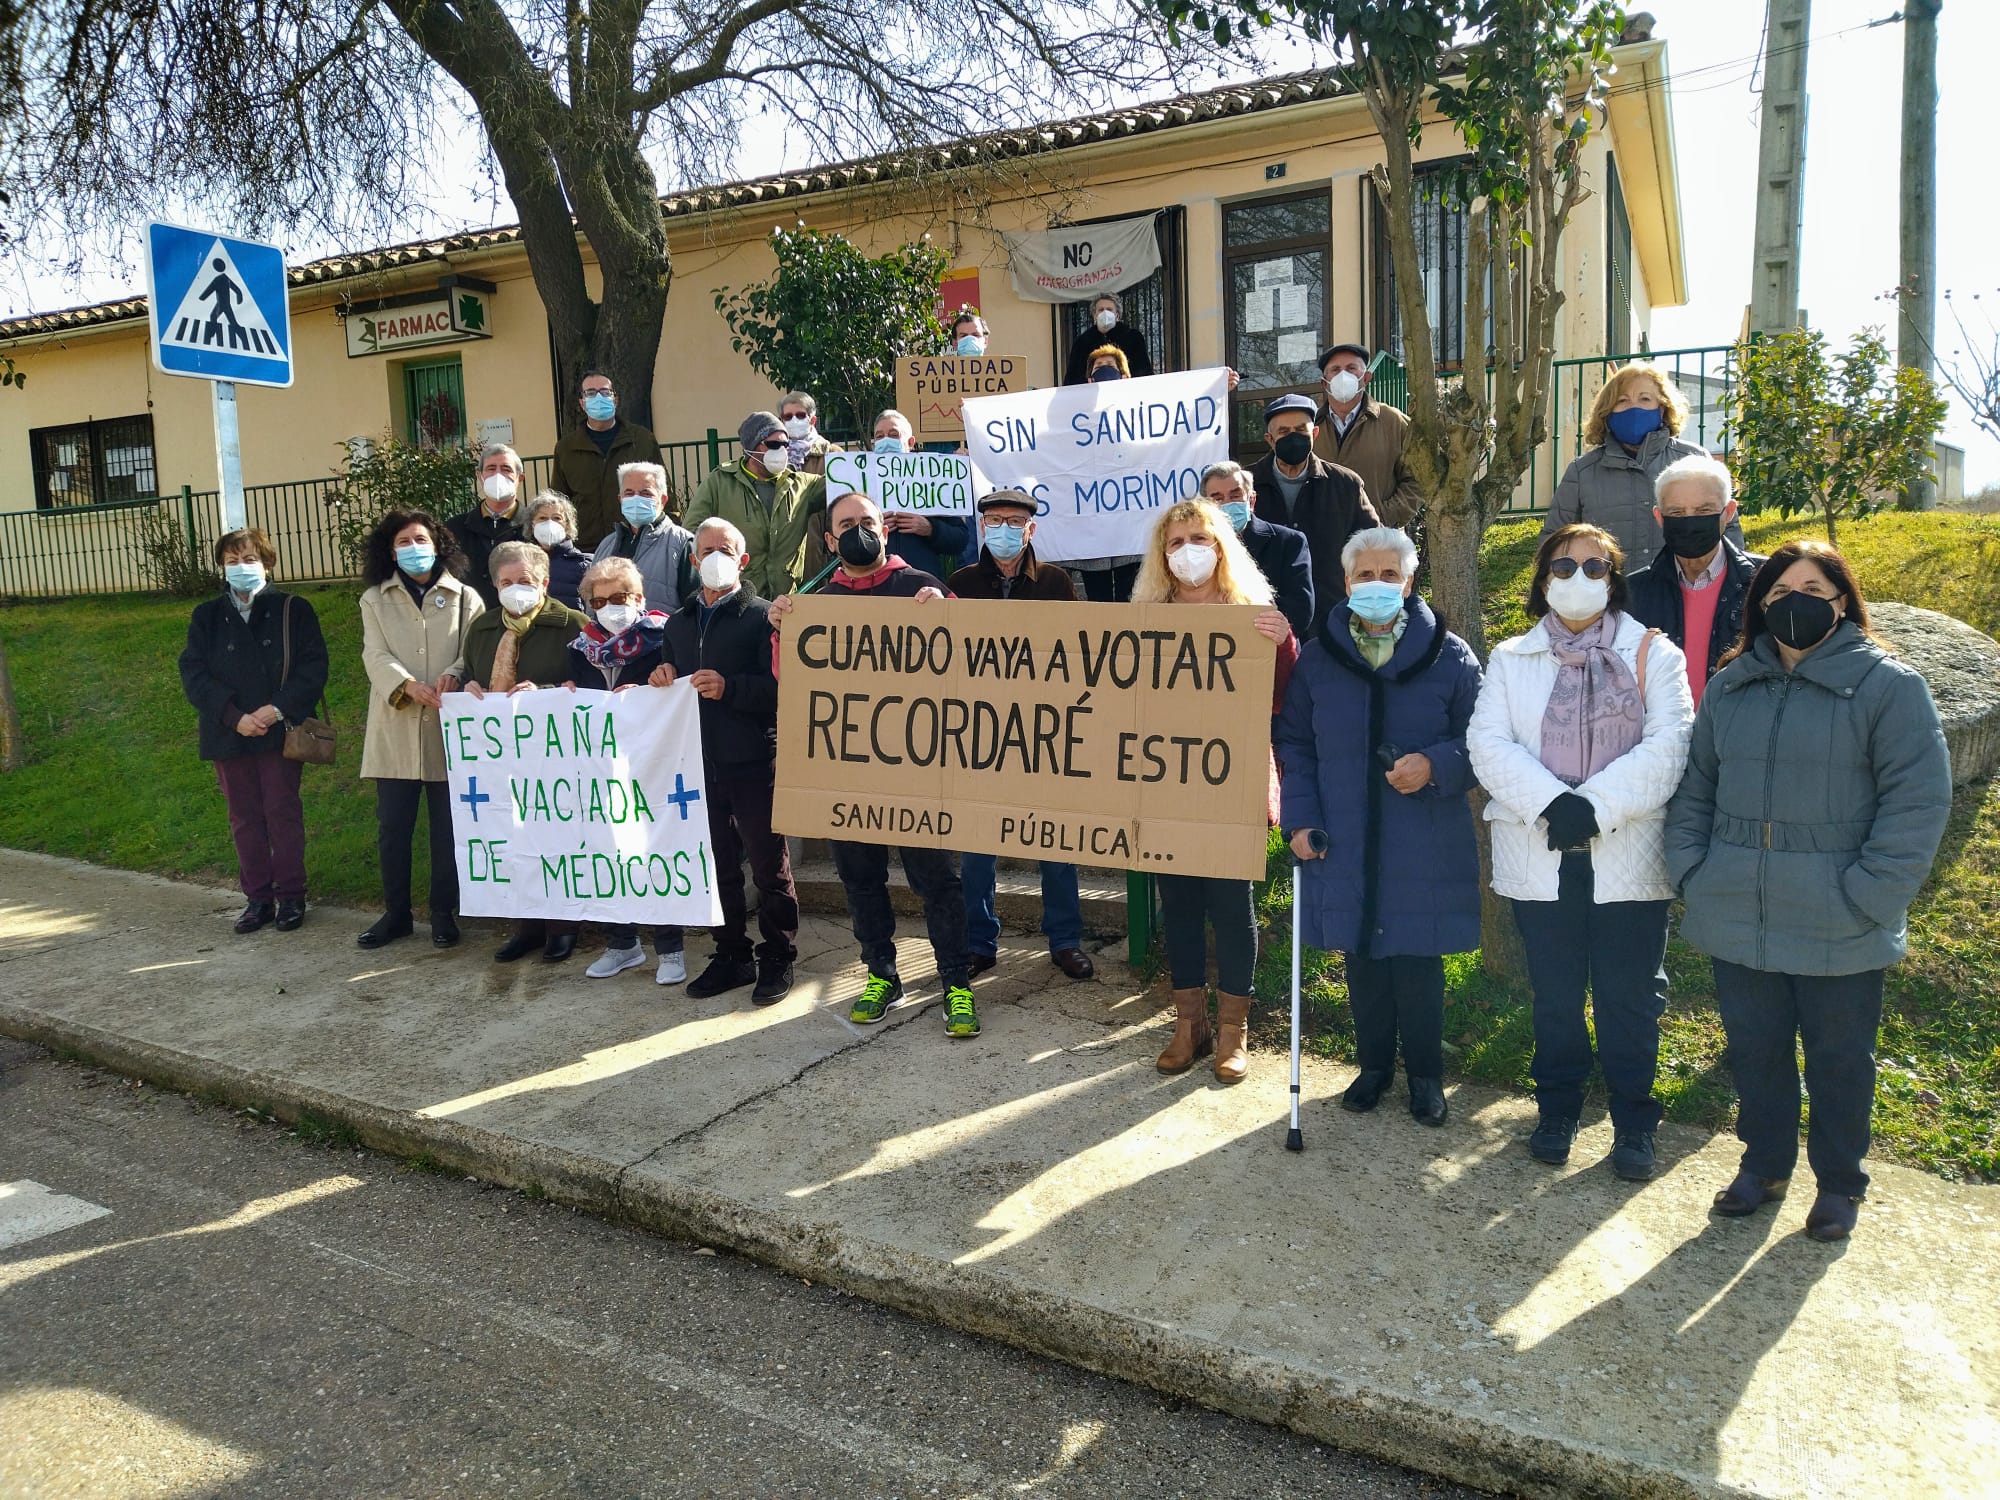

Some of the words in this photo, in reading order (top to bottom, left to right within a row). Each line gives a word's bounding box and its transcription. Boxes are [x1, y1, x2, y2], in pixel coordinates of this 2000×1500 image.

[1272, 165, 1279, 178] 2
[1063, 241, 1093, 269] NO
[1036, 263, 1122, 289] MACROGRANJAS
[377, 311, 450, 341] FARMAC
[909, 359, 1013, 377] SANIDAD
[917, 377, 1008, 394] PÚBLICA
[986, 416, 1036, 454] SIN
[876, 456, 968, 481] SANIDAD
[882, 480, 966, 510] PÚBLICA
[1074, 464, 1211, 515] MORIMO
[797, 624, 953, 676] CUANDO
[964, 636, 1036, 680] VAYA
[1044, 639, 1070, 683] A
[1078, 630, 1237, 692] VOTAR
[807, 690, 1093, 778] RECORDARÉ
[1117, 732, 1231, 786] ESTO
[510, 771, 655, 824] VACIADA
[831, 802, 953, 836] SANIDAD
[467, 838, 511, 883] DE
